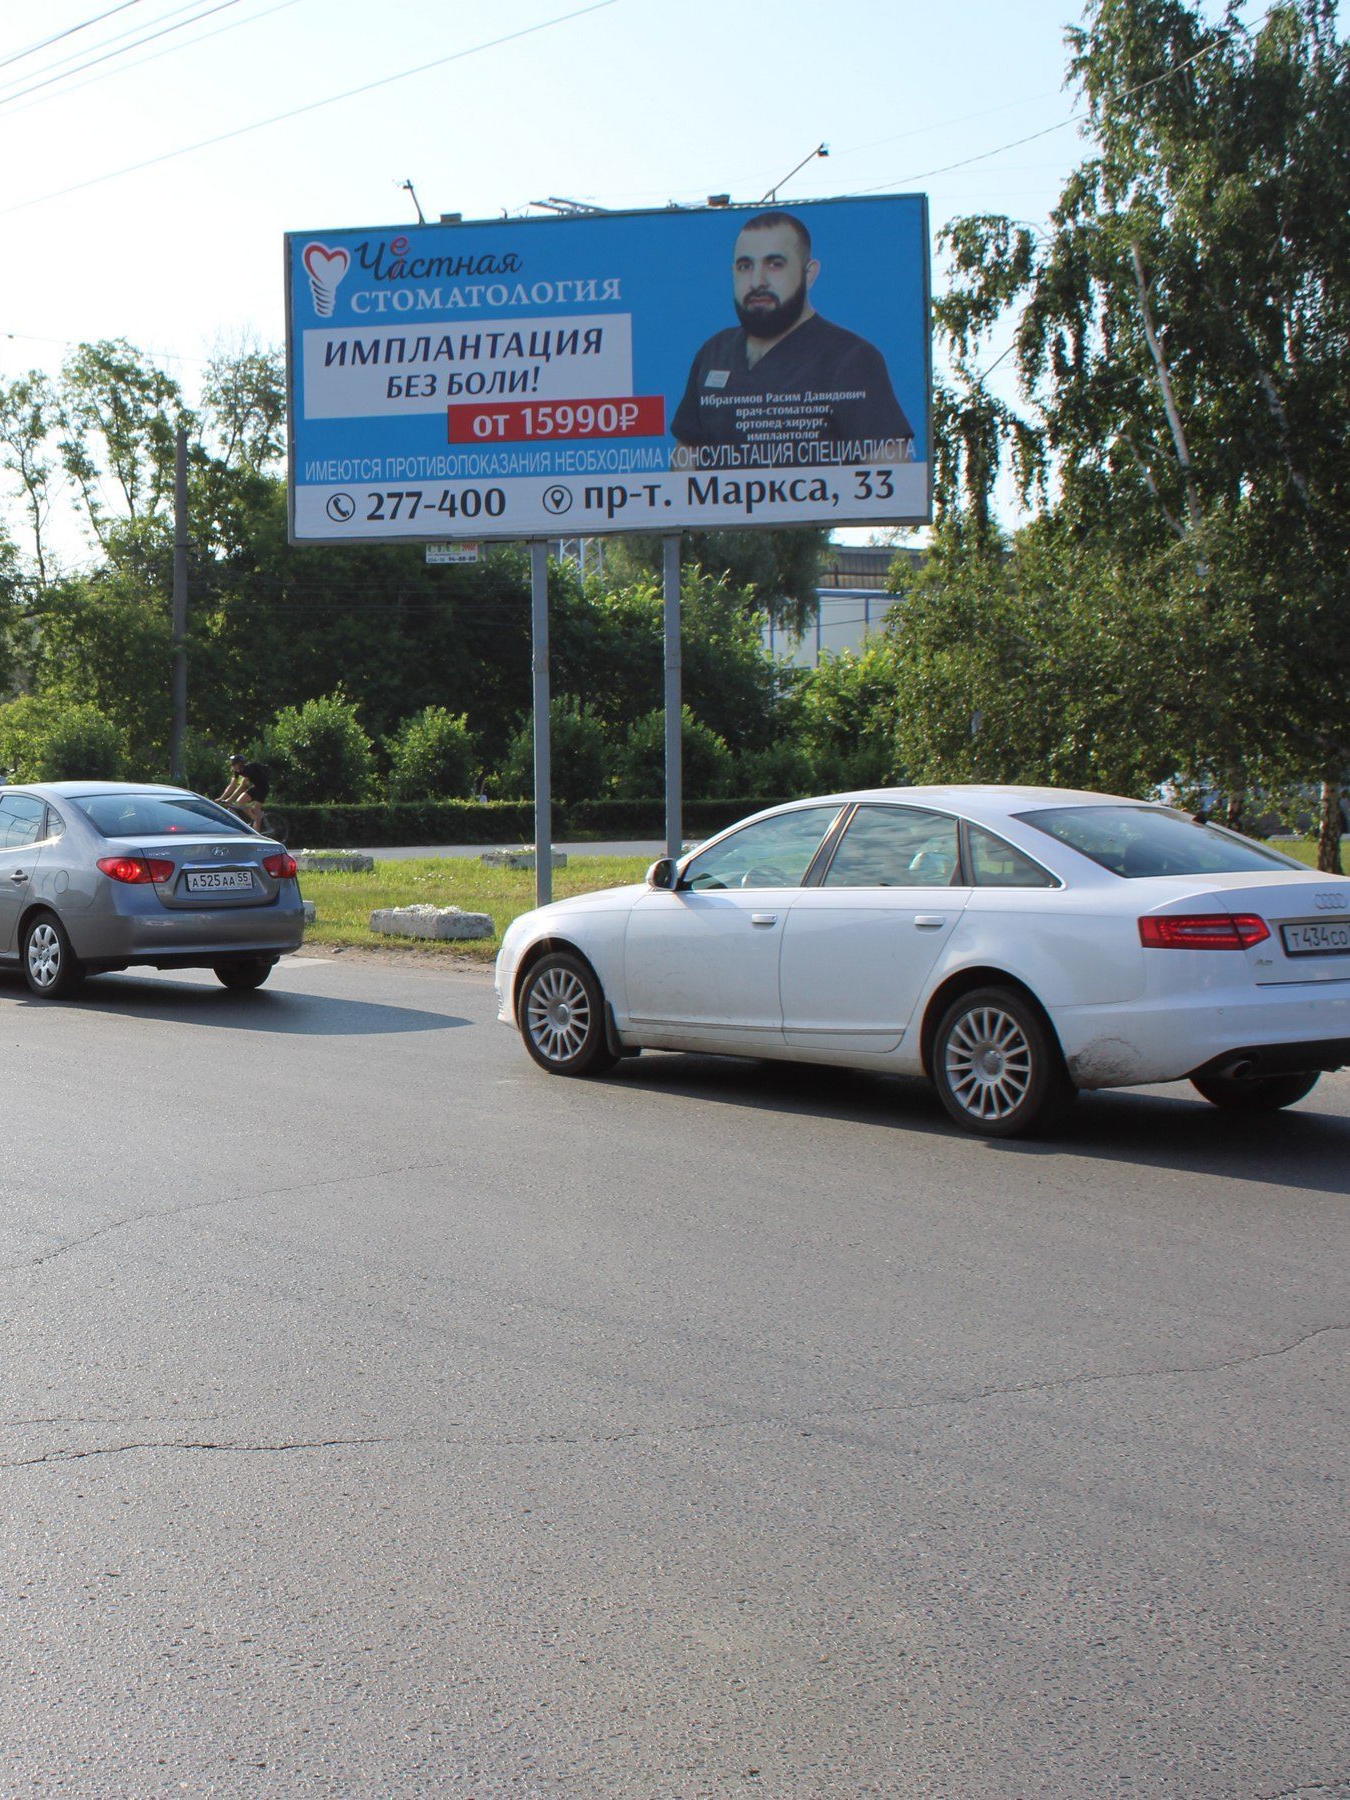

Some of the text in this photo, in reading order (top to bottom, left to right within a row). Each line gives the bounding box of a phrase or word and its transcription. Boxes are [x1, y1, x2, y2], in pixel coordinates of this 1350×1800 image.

[351, 278, 622, 314] СТОМАТОЛОГИЯ
[324, 328, 603, 367] ИМПЛАНТАЦИЯ
[386, 366, 540, 399] БЕЗ БОЛИ!
[700, 389, 866, 408] Ибрагимов Расим Давидович
[473, 414, 510, 437] от
[735, 404, 834, 418] врач-стоматолог,
[735, 417, 828, 430] ортопед-хирург,
[746, 430, 821, 442] имплантолог
[305, 438, 917, 481] ИМЕЮТСЯ ПРОТИВОПОКАЗАНИЯ НЕОБХОДИМА КОНСУЛЬТАЦИЯ СПЕЦИАЛИСТА
[366, 488, 506, 521] 277-400
[584, 470, 895, 519] пр-т. Маркса, 33
